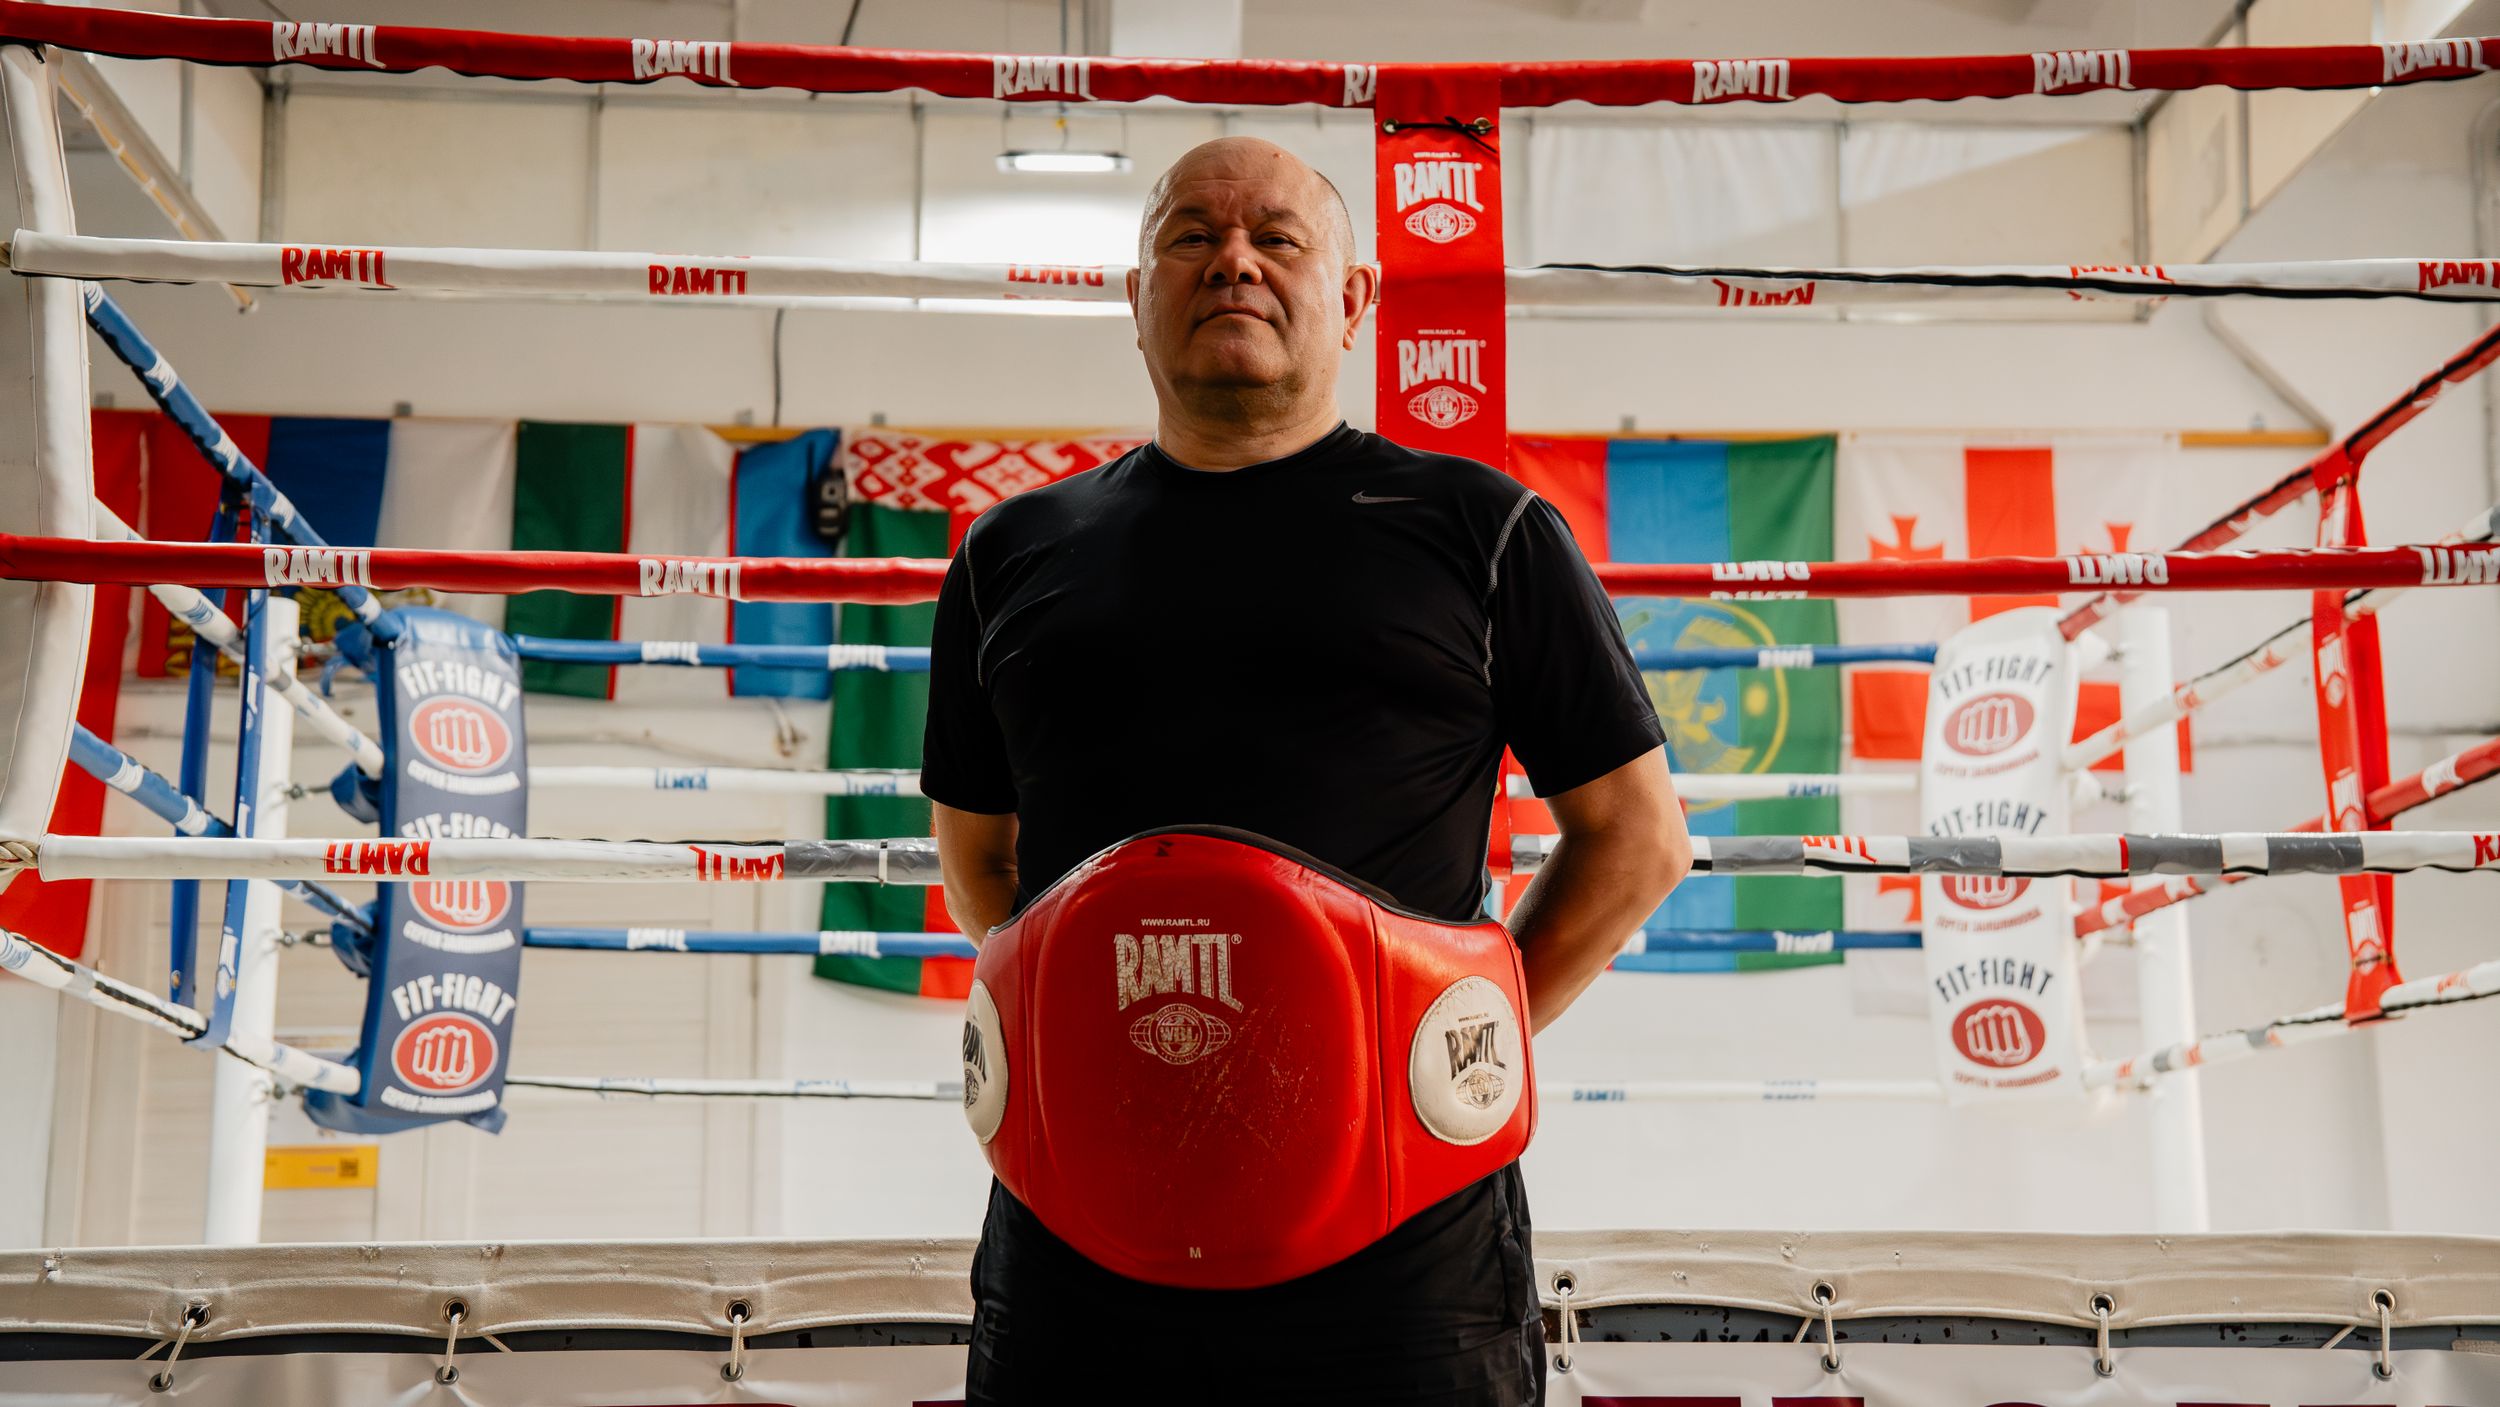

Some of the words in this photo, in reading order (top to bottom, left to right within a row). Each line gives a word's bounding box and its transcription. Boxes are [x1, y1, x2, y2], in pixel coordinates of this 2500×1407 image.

[272, 20, 387, 69] RAMTL
[630, 38, 740, 87] RAMTL
[992, 55, 1099, 101] RAMTL
[1691, 58, 1797, 104] RAMTL
[2031, 48, 2137, 94] RAMTL
[281, 247, 397, 288] RAMTL
[399, 659, 521, 713] FIT-FIGHT
[1940, 655, 2053, 699] FIT-FIGHT
[1141, 918, 1211, 927] WWW.RAMTL.RU
[391, 972, 516, 1026] FIT-FIGHT
[1935, 957, 2053, 1003] FIT-FIGHT
[1189, 1246, 1202, 1259] M
